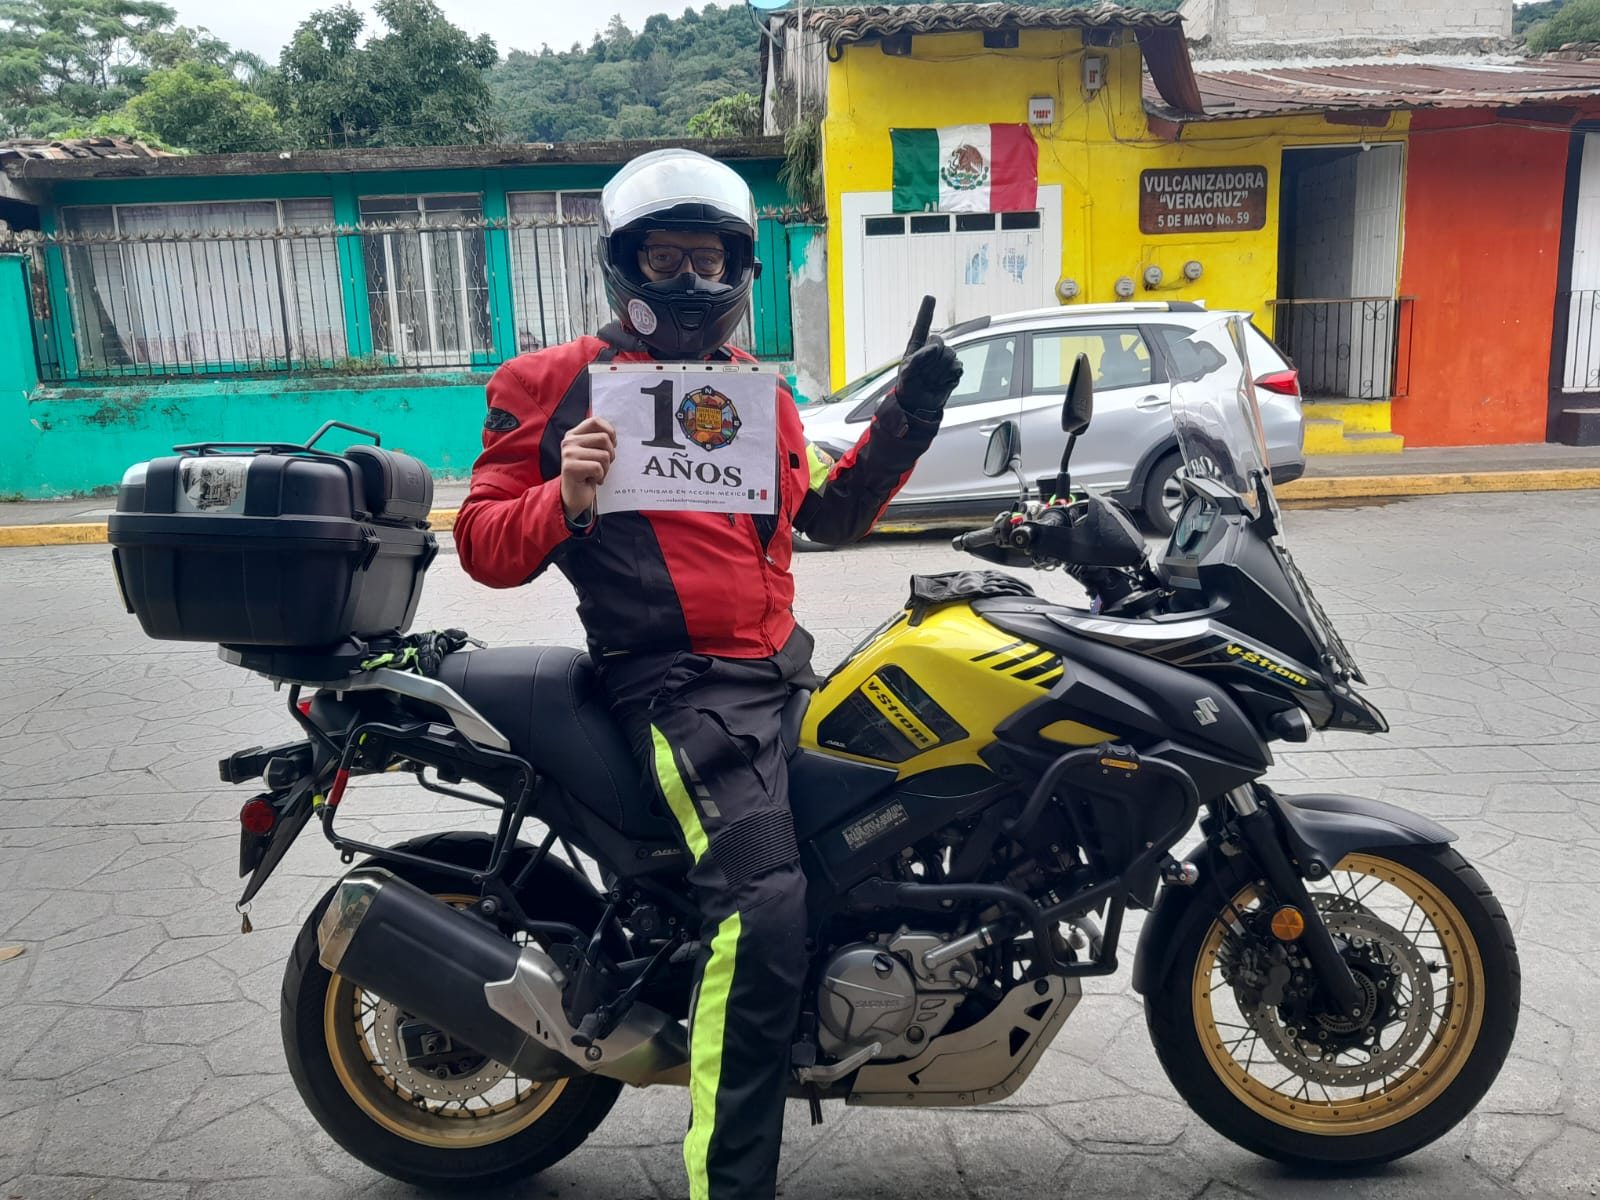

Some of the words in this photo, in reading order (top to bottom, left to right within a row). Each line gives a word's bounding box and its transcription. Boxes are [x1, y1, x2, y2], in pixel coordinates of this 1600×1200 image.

[1144, 173, 1264, 192] VULCANIZADORA
[1159, 191, 1249, 209] “VERACRUZ”
[1158, 215, 1165, 227] 5
[1167, 214, 1181, 228] DE
[1184, 213, 1214, 227] MAYO
[1217, 212, 1234, 226] No.
[1236, 211, 1250, 225] 59
[641, 451, 743, 488] AÑOS
[1226, 644, 1308, 685] V-Strom
[867, 681, 930, 743] V-Strom
